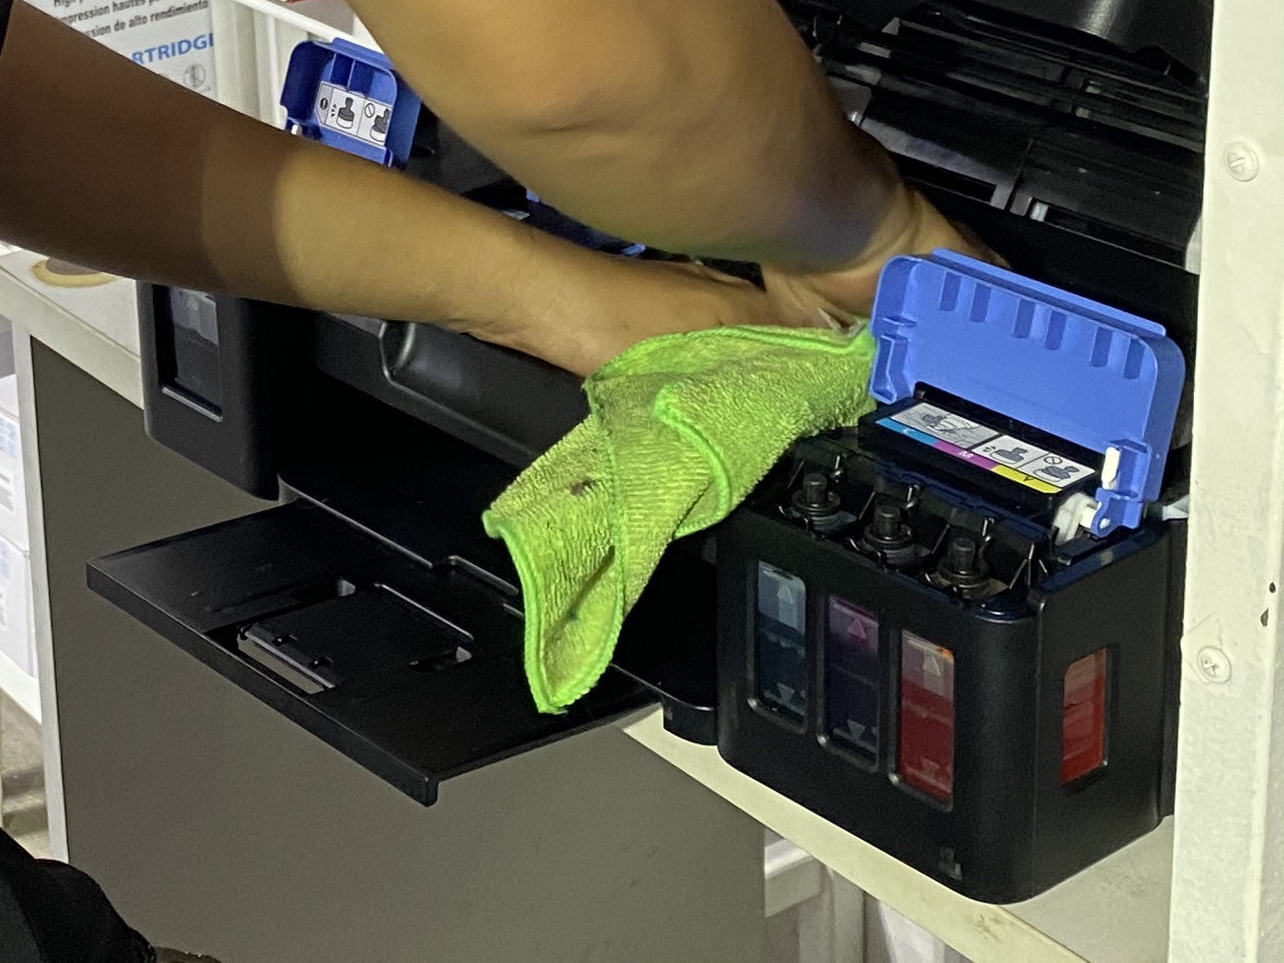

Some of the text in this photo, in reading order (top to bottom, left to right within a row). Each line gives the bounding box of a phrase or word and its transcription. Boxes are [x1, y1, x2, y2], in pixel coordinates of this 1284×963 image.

[113, 19, 126, 33] de
[128, 14, 148, 28] alto
[150, 0, 210, 23] rendimiento
[132, 33, 214, 64] RTRIDG
